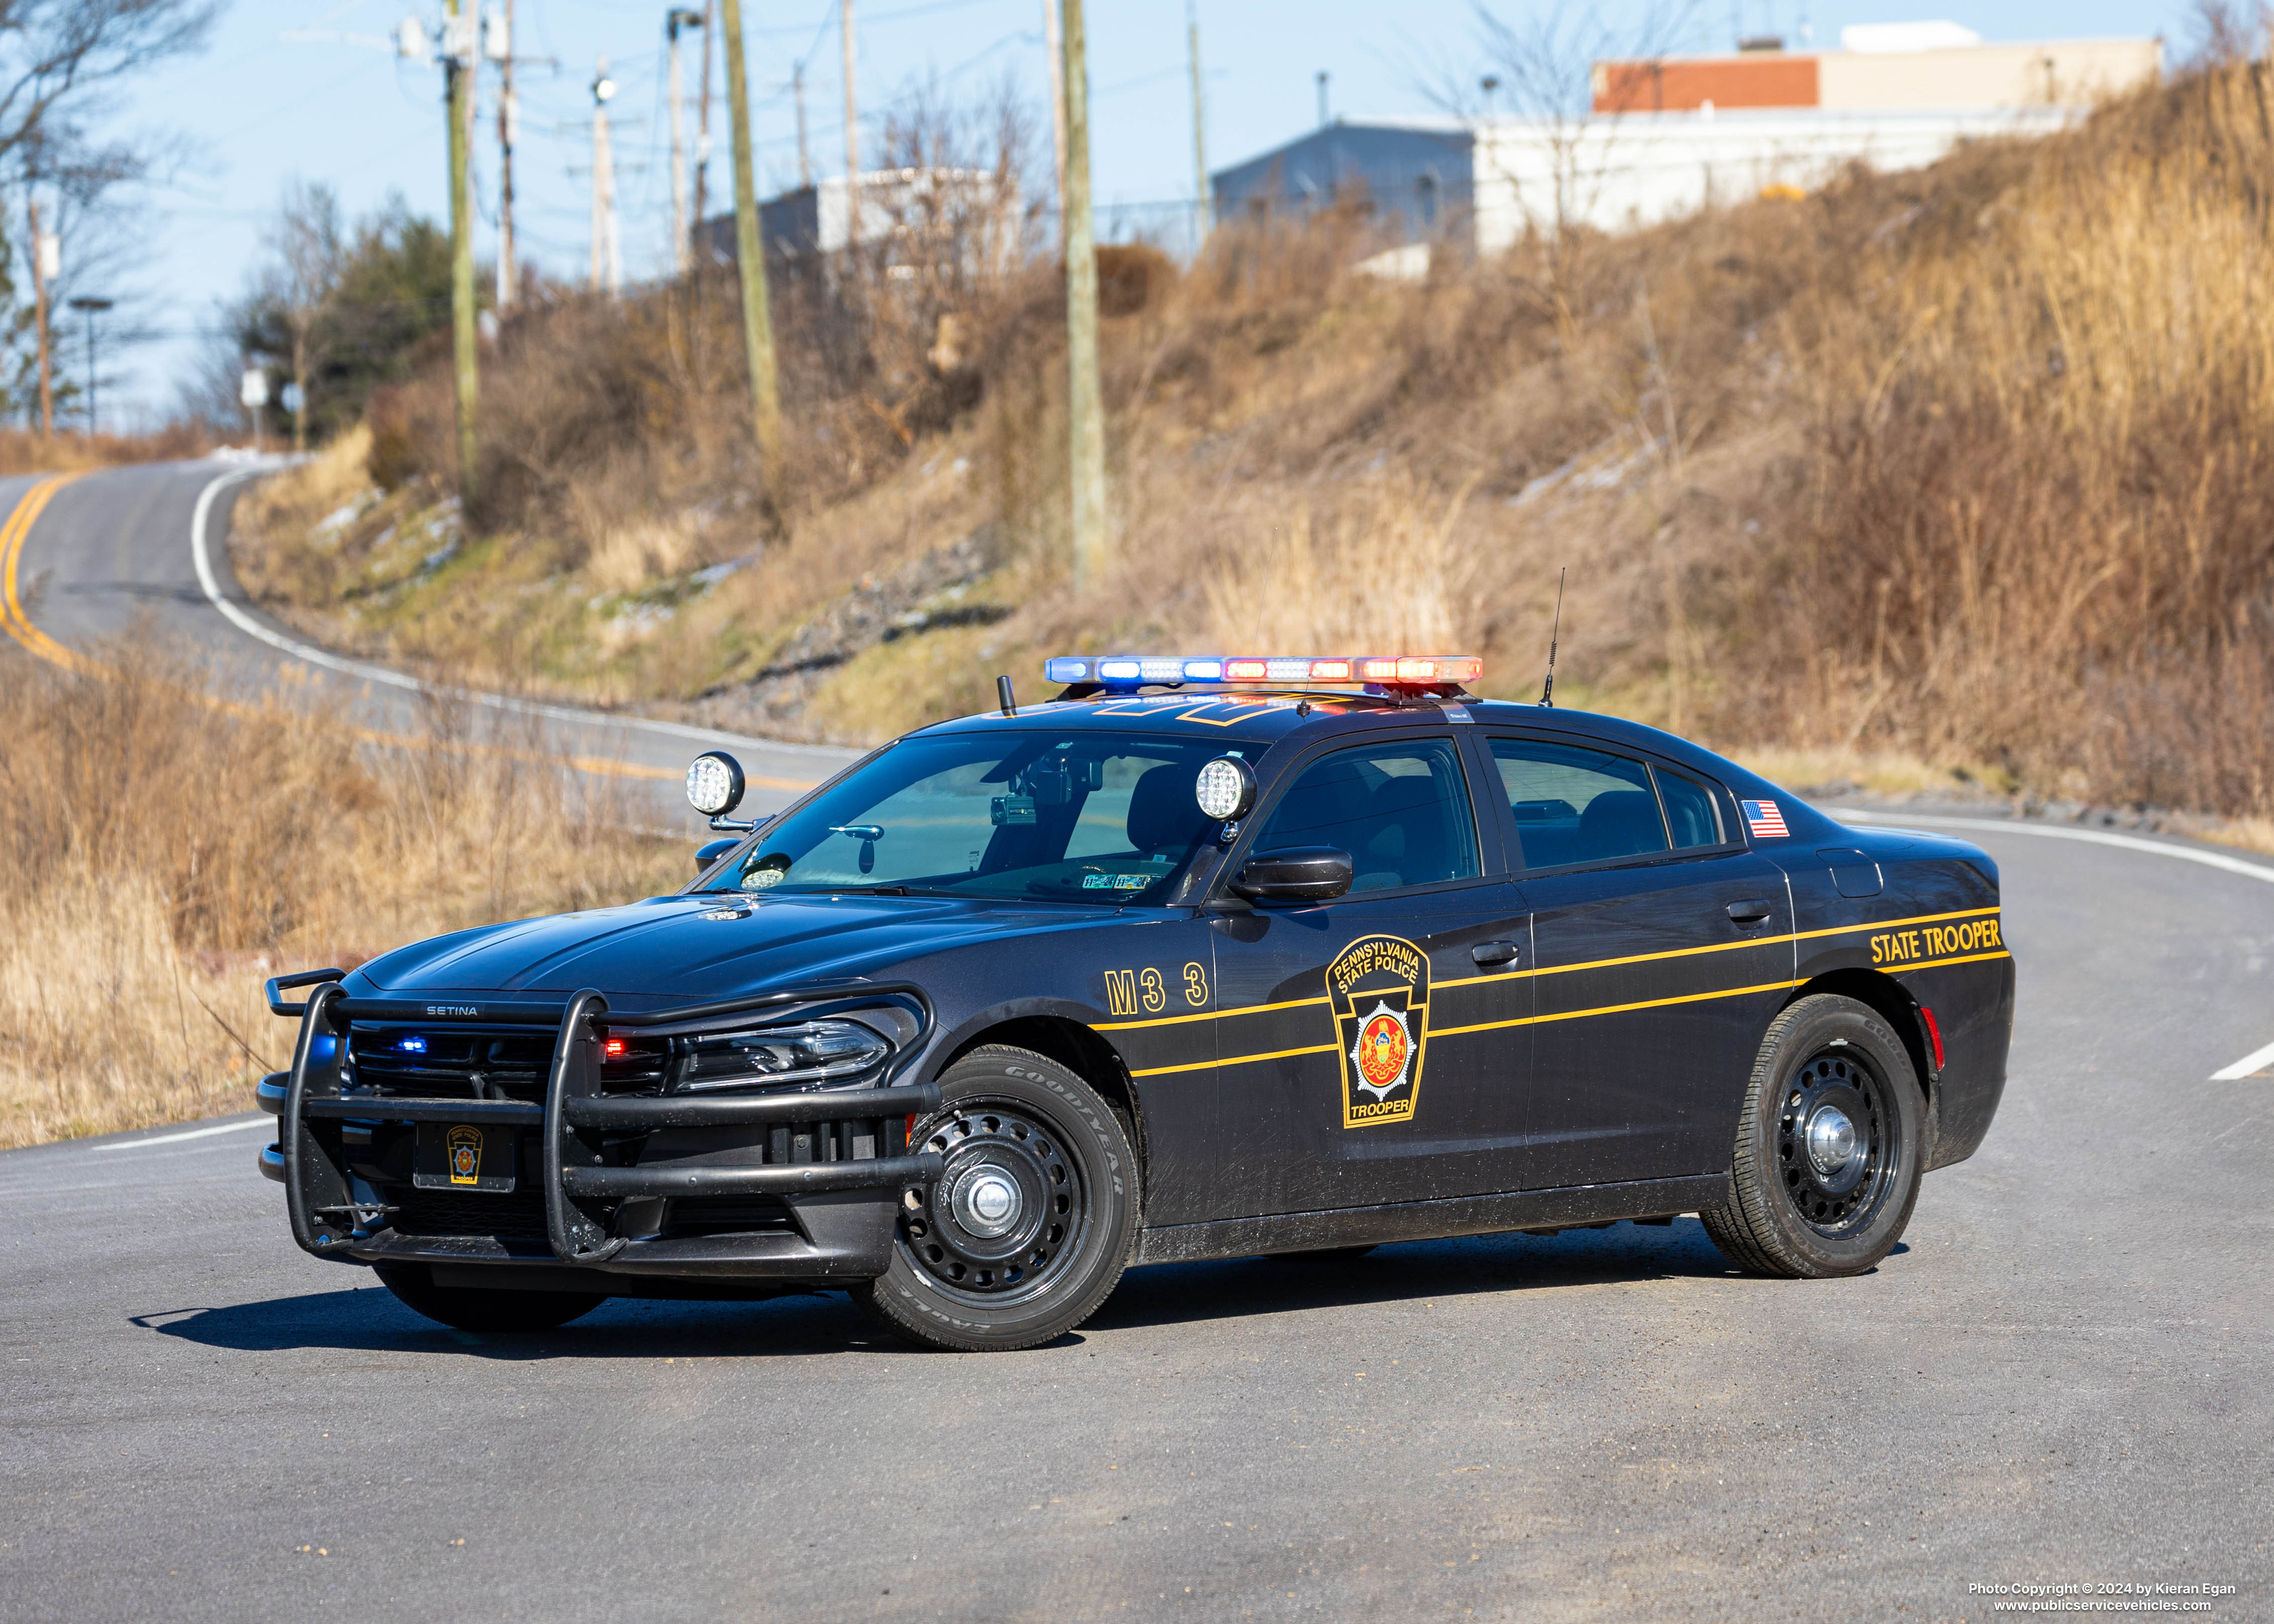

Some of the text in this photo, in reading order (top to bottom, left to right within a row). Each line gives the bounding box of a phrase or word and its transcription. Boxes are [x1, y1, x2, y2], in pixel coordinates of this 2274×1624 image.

[1085, 878, 1094, 887] 11
[1116, 878, 1125, 887] 11
[1871, 919, 2001, 963] STATE TROOPER
[1334, 942, 1418, 981] PENNSYLVANIA
[1338, 956, 1418, 994] STATE POLICE
[427, 1006, 477, 1015] SETINA
[1351, 1099, 1409, 1118] TROOPER
[1005, 1066, 1124, 1196] GOODYEAR
